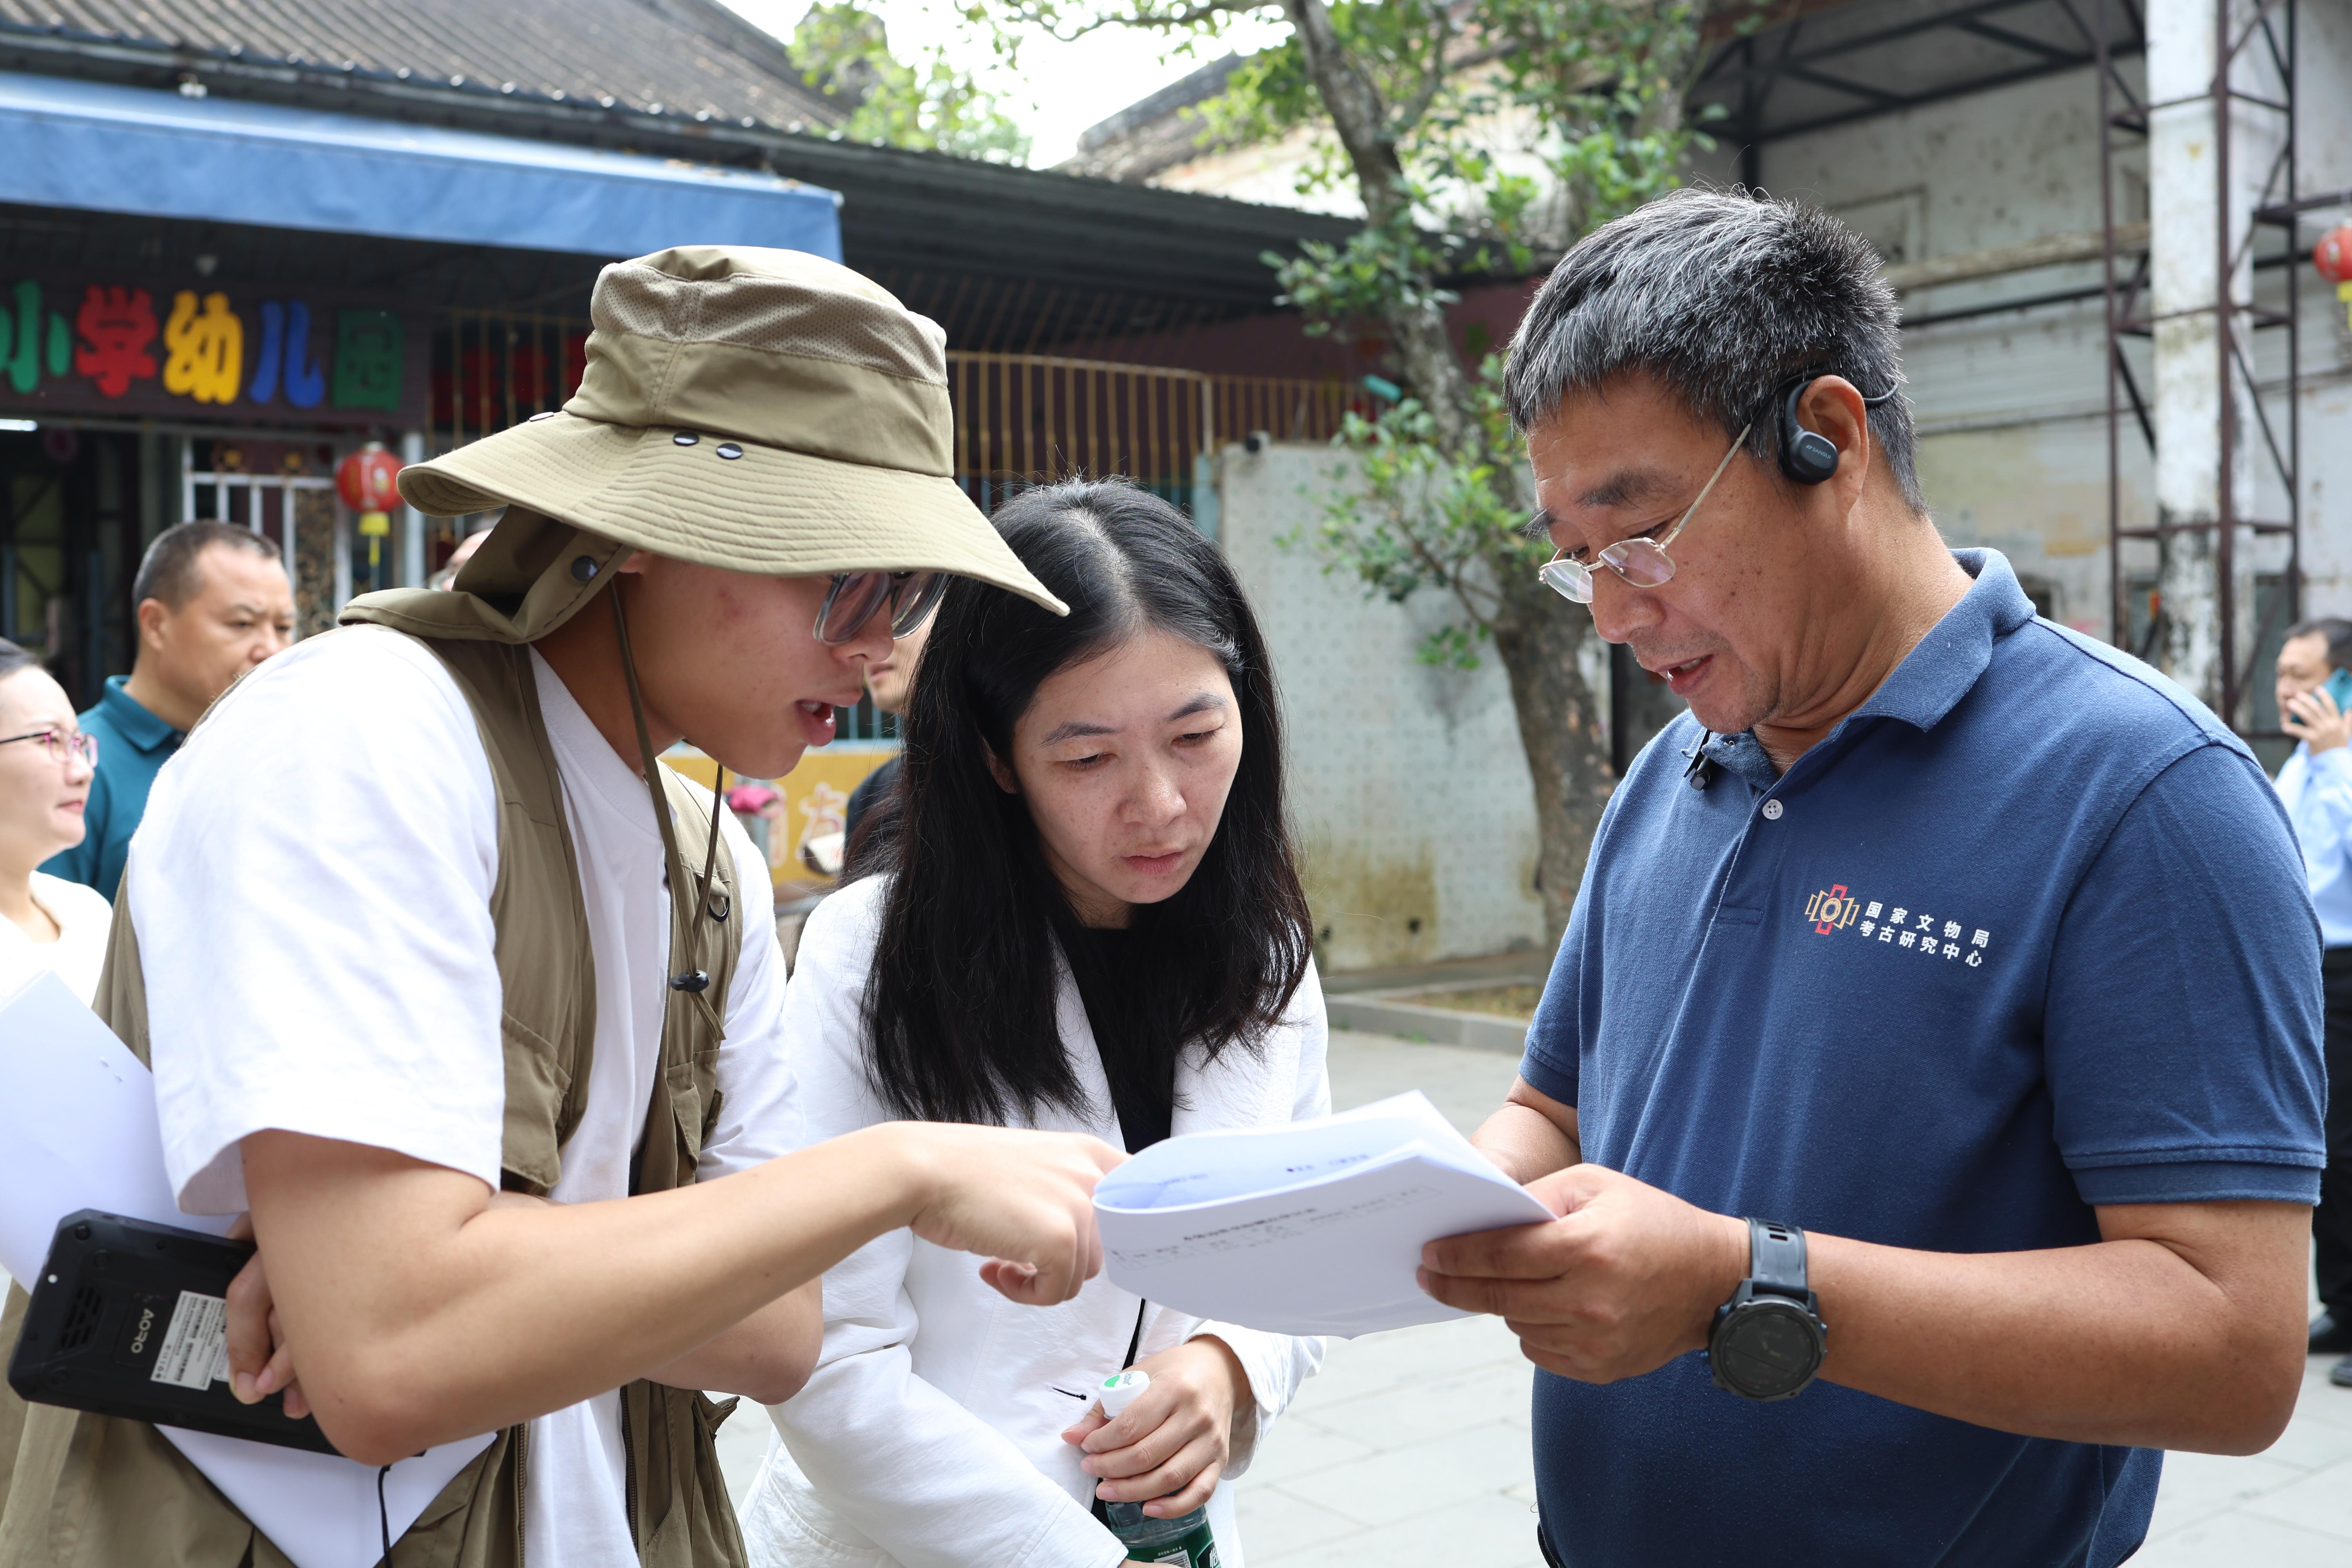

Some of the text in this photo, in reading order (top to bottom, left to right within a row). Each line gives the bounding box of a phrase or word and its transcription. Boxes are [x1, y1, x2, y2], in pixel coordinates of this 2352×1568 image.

[0, 278, 403, 410] 小学幼儿园
[1812, 447, 1831, 459] SANSUI
[1860, 920, 1982, 967] 考古研究中心
[1865, 901, 1990, 948] 国家文物局
